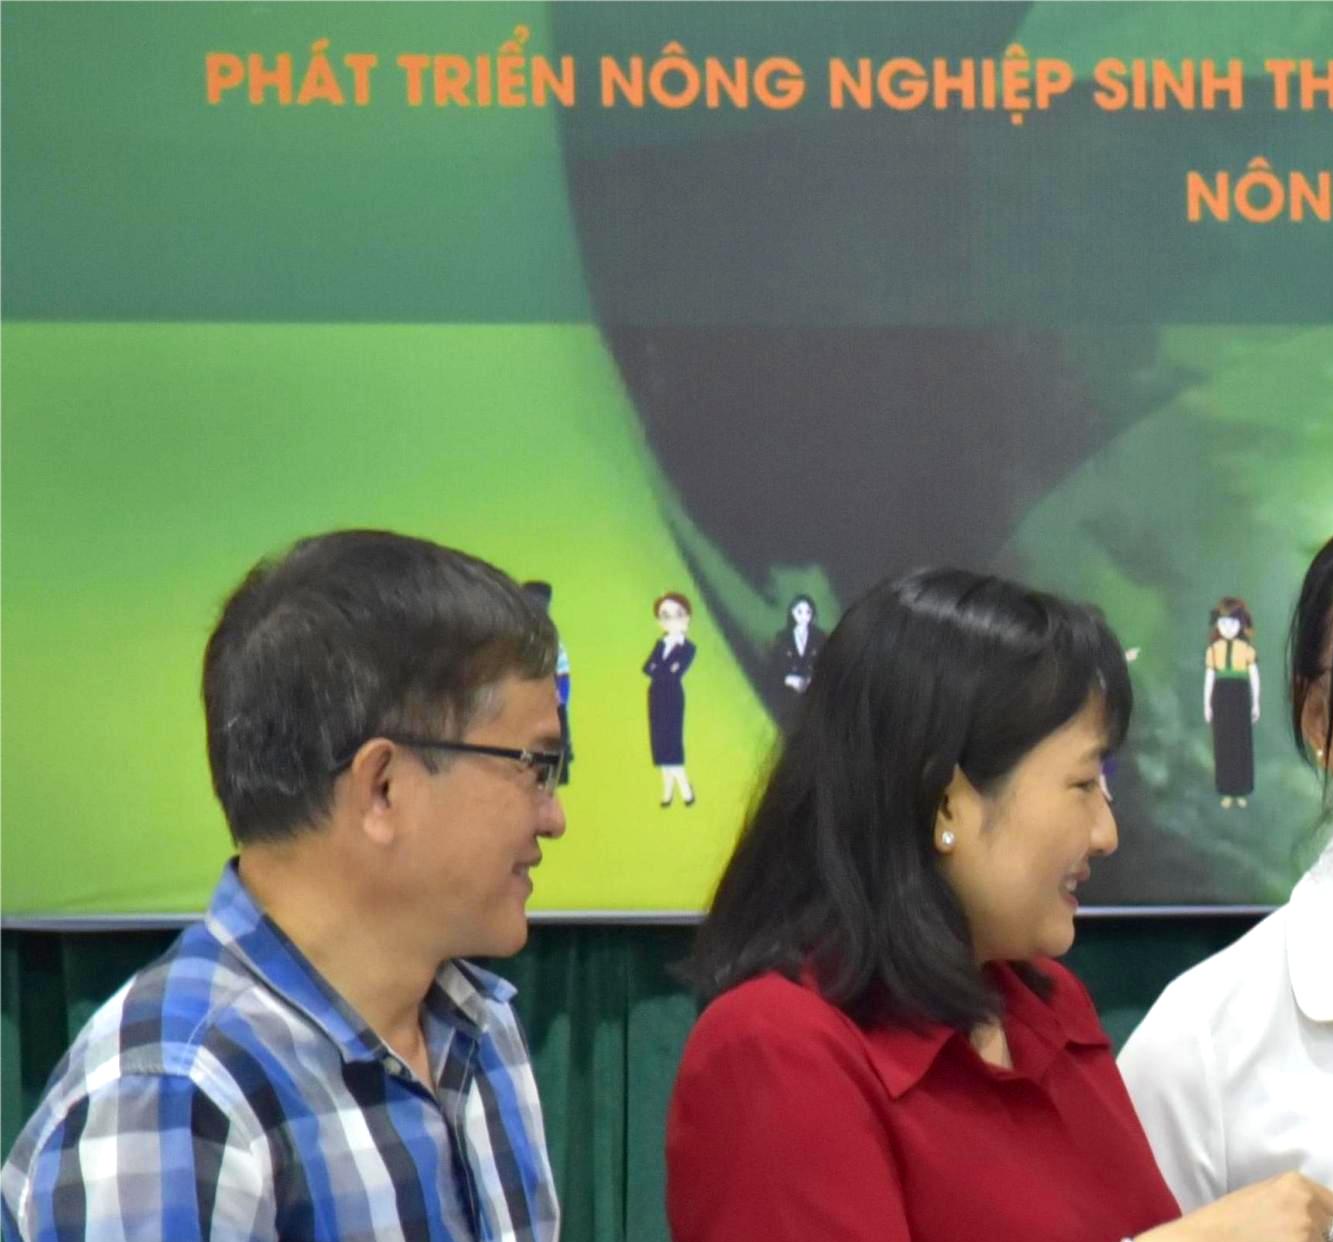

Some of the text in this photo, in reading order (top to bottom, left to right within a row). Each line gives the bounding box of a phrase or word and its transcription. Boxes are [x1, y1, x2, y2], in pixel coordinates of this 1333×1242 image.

[206, 38, 377, 105] PHÁT
[397, 26, 577, 108] TRIỂN
[600, 41, 807, 110] NÔNG
[828, 44, 1074, 126] NGHIỆP
[1094, 58, 1245, 112] SINH
